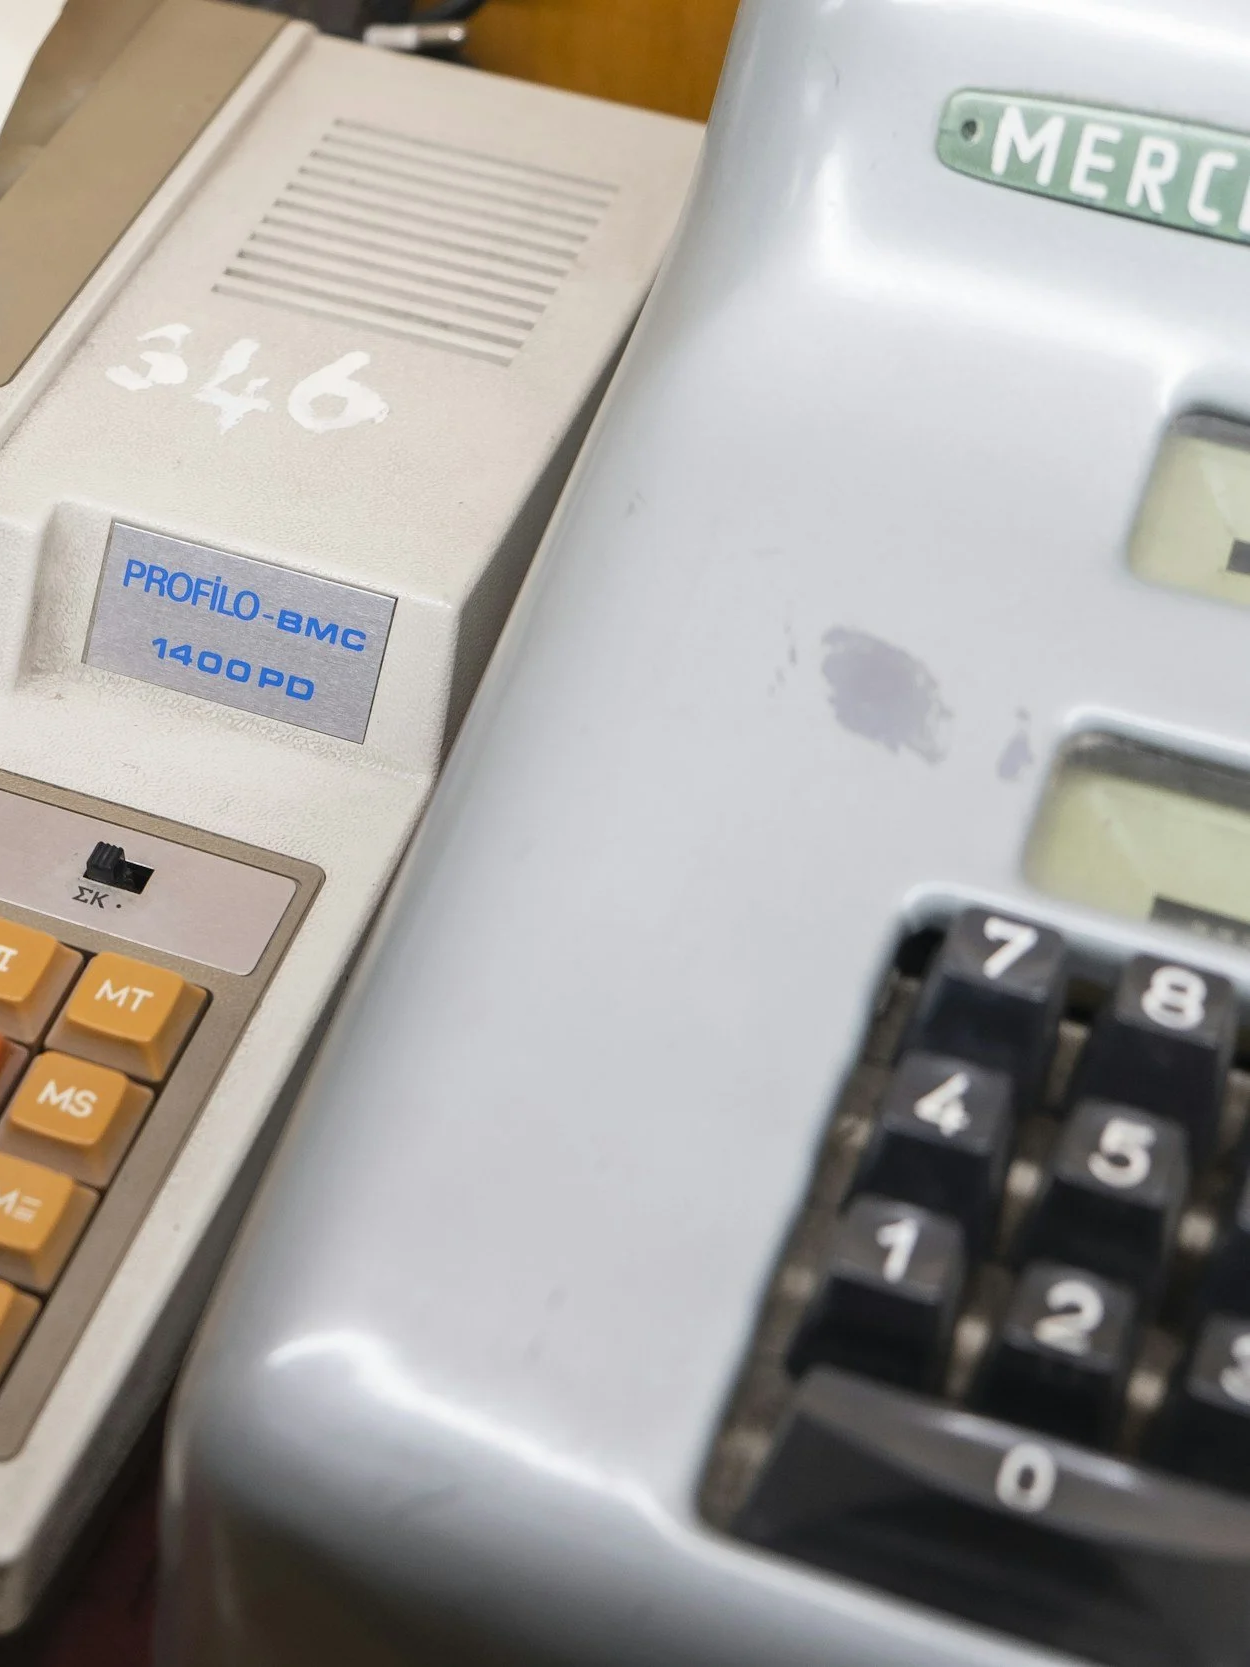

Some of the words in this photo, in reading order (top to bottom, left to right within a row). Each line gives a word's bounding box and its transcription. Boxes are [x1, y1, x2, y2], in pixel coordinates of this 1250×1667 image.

[991, 105, 1250, 234] MERC
[105, 323, 390, 434] 346
[151, 637, 249, 684] 1400
[257, 668, 315, 701] PD
[983, 916, 1039, 979] 7
[94, 979, 154, 1012] MT
[1142, 965, 1207, 1030] 8
[37, 1080, 98, 1118] MS
[913, 1071, 971, 1138] 4
[1087, 1117, 1156, 1190] 5
[876, 1217, 919, 1283] 1
[1033, 1279, 1105, 1356] 2
[996, 1442, 1057, 1513] 0
